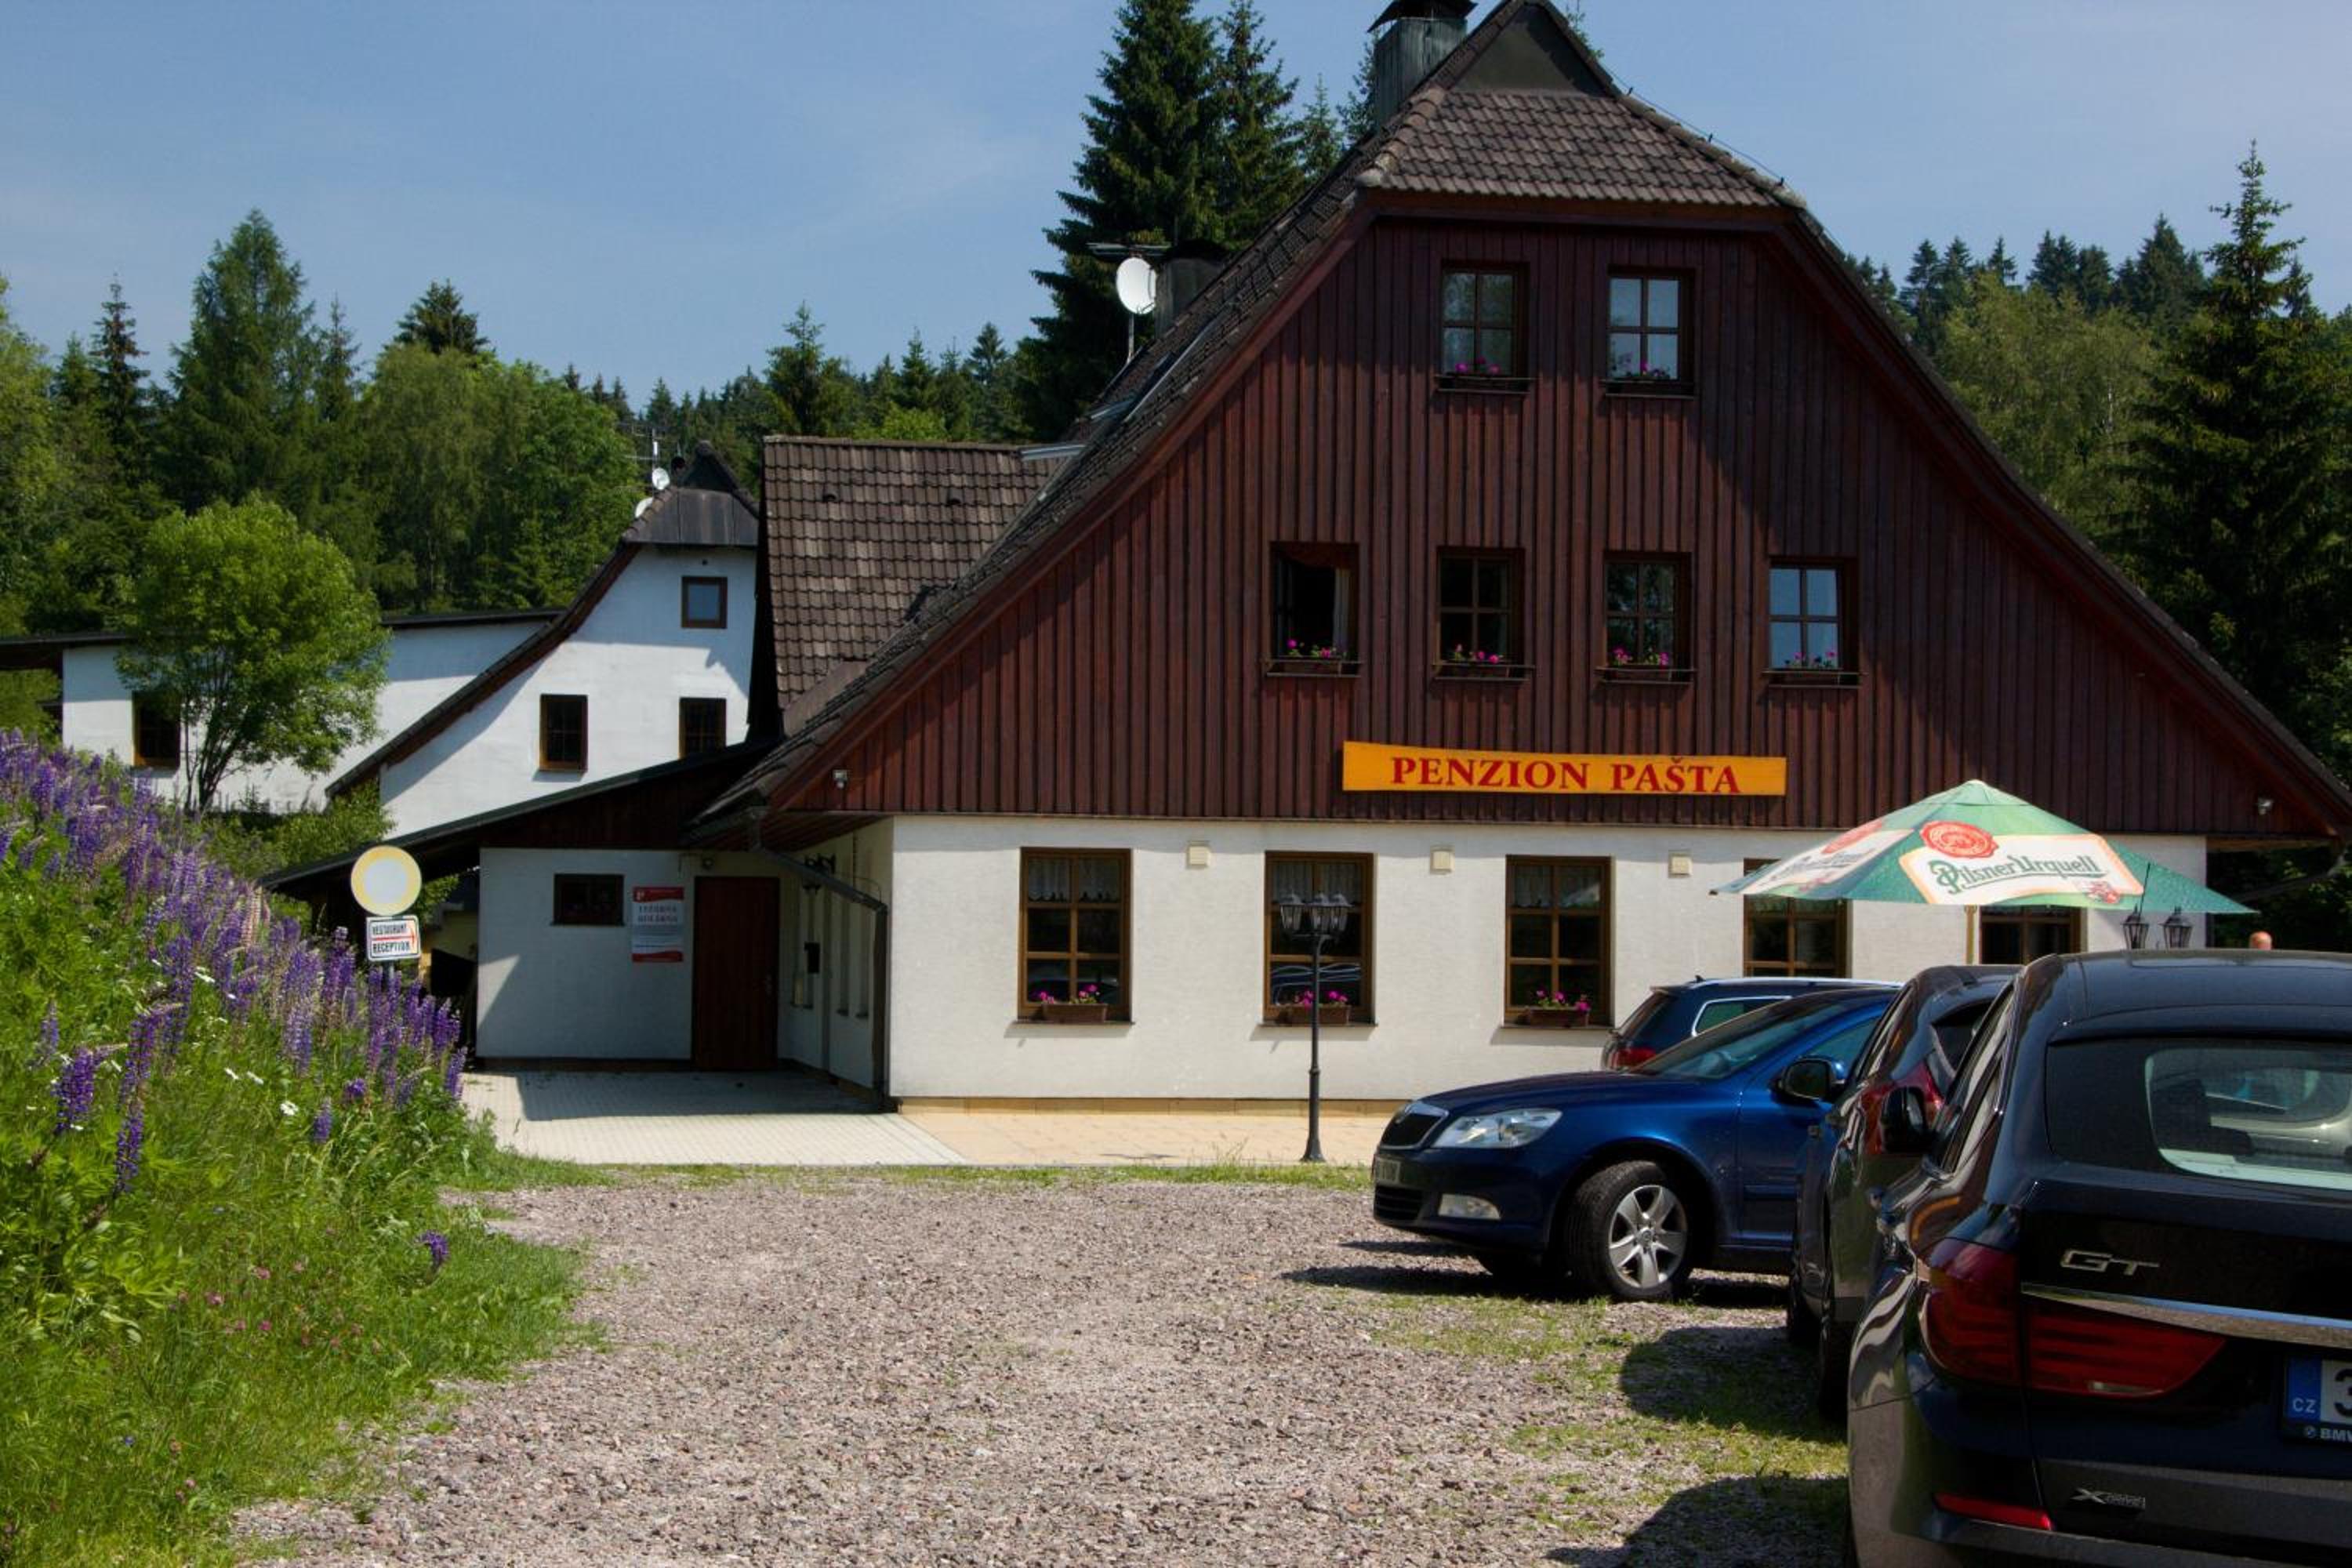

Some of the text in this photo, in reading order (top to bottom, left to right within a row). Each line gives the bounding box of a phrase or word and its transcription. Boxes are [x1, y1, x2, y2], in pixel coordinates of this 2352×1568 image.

[1392, 756, 1741, 794] PENZION PAŠTA
[1928, 855, 2100, 895] Pilsner Urquell
[372, 941, 410, 954] RECEPTION
[2060, 1249, 2160, 1276] GT
[2292, 1397, 2317, 1414] CZ
